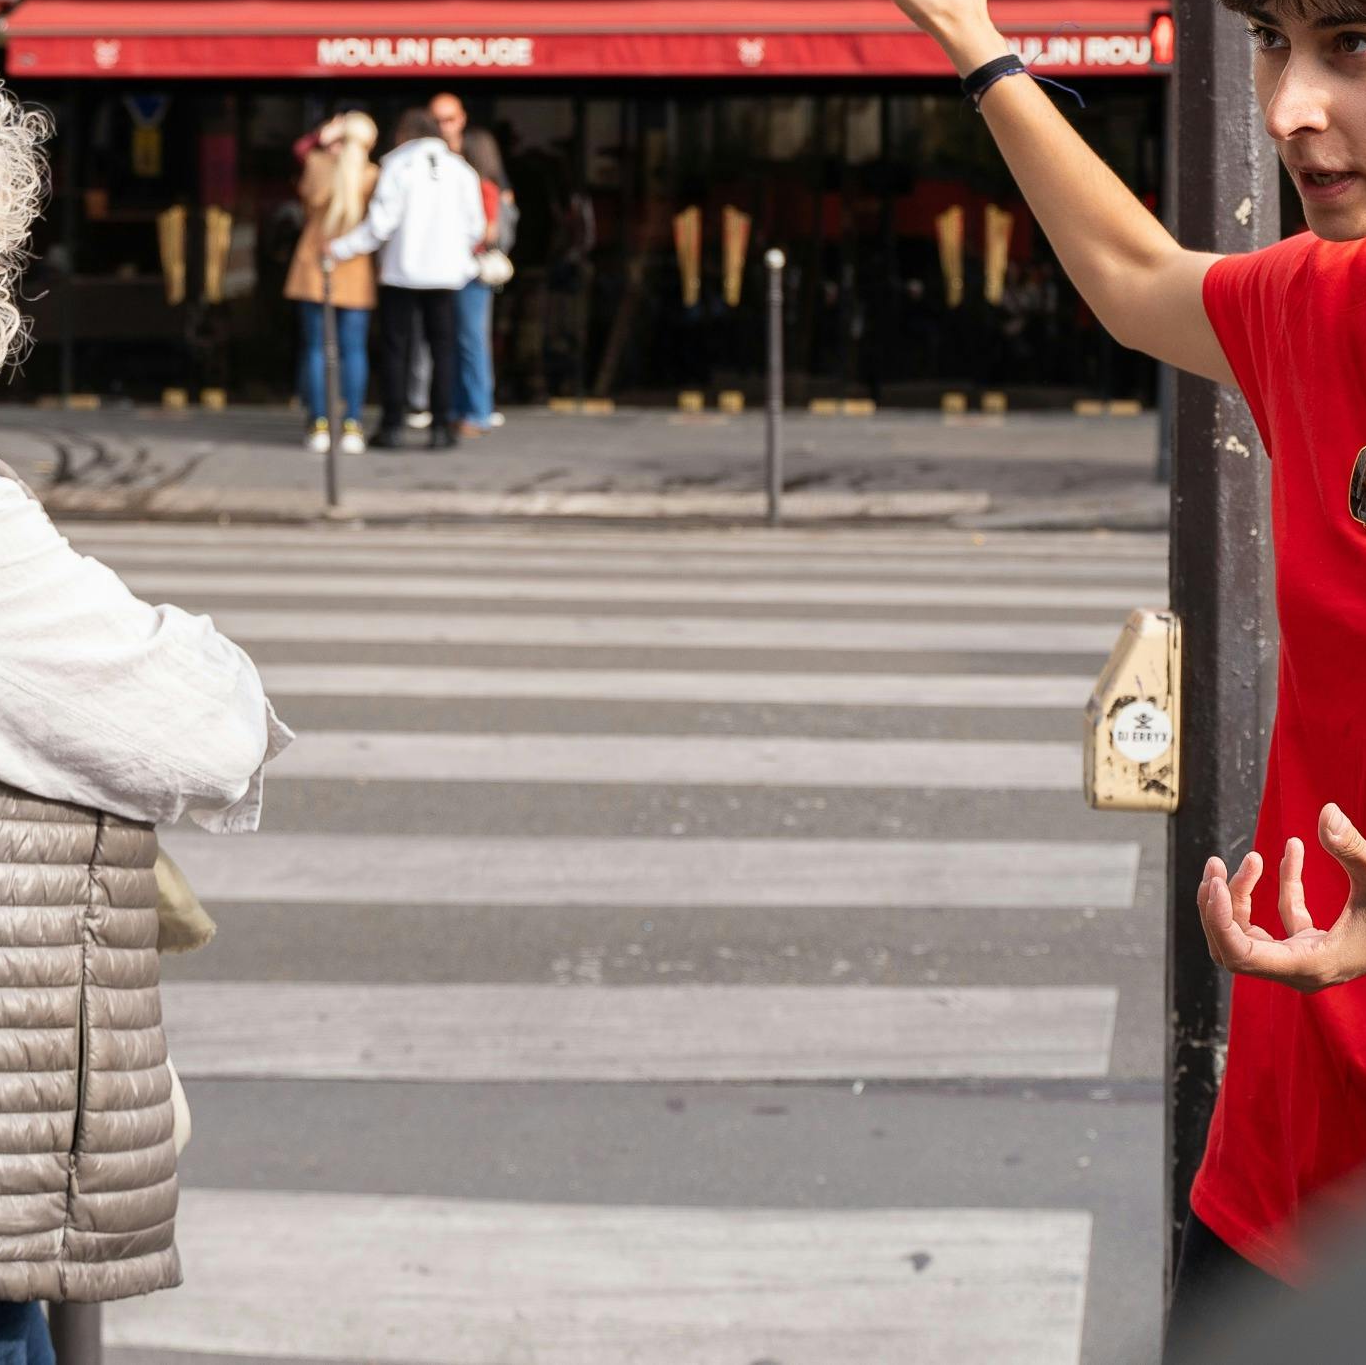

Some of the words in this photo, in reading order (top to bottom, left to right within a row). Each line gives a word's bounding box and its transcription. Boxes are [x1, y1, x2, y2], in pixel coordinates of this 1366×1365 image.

[317, 37, 430, 67] MOULIN
[431, 37, 534, 67] ROUGE
[1084, 36, 1152, 66] ROU
